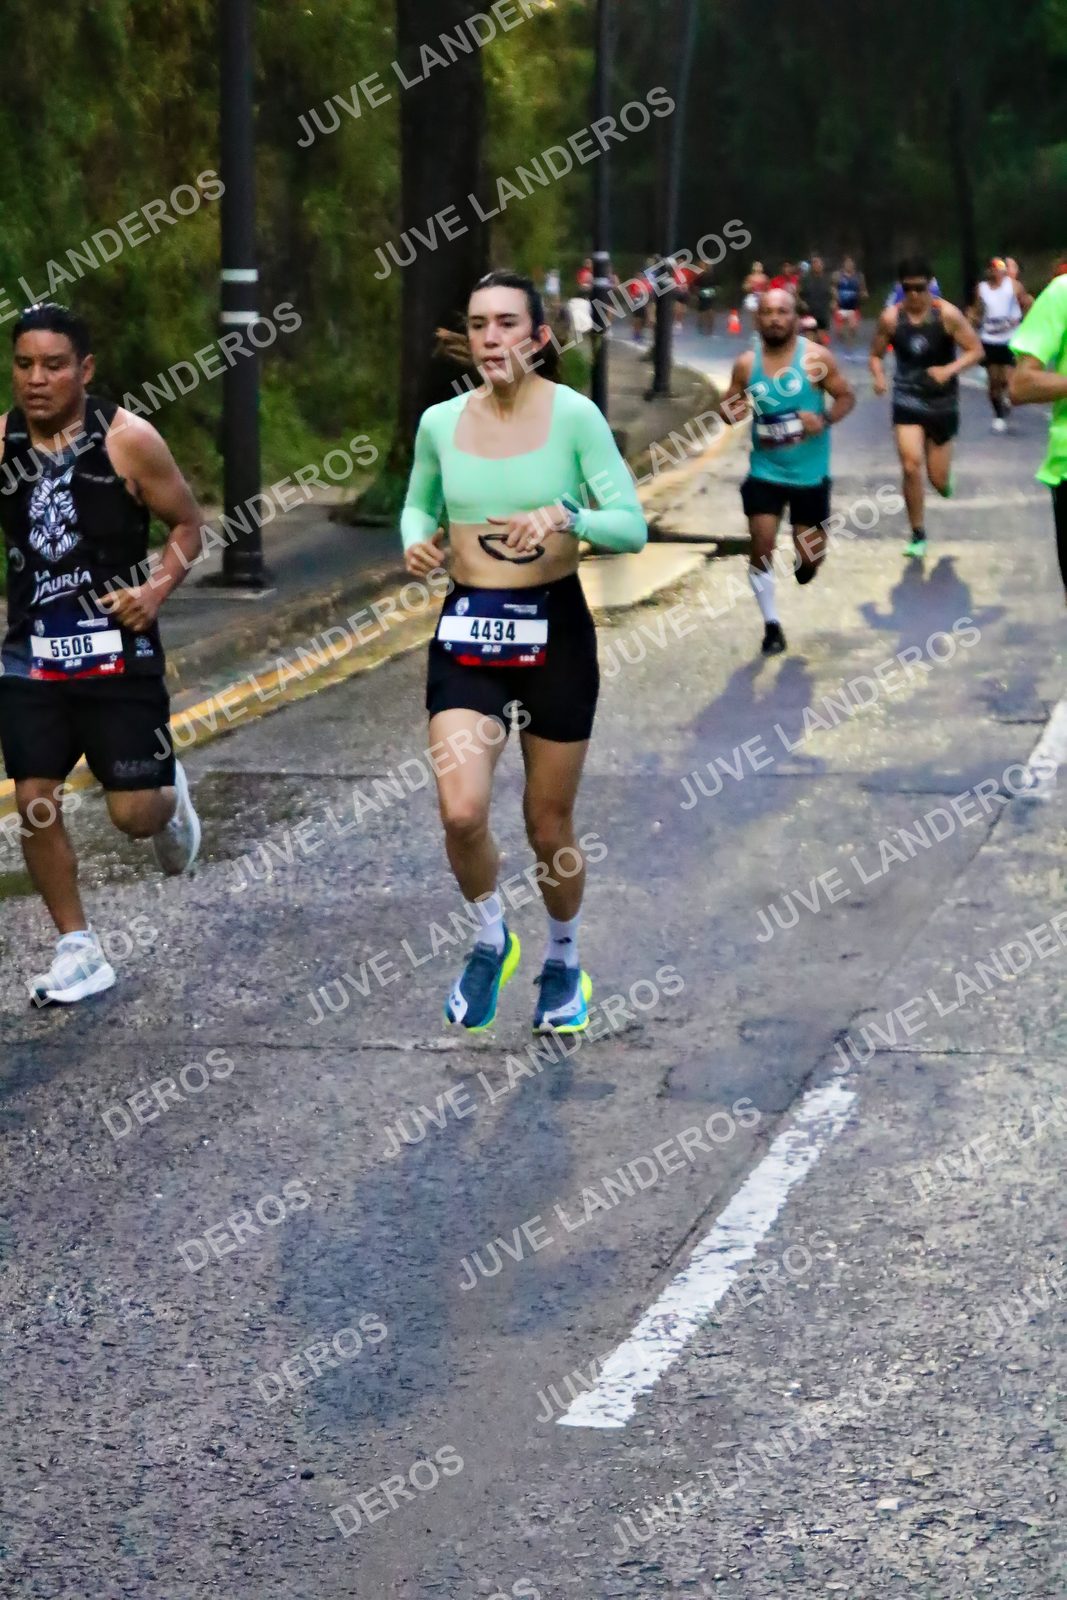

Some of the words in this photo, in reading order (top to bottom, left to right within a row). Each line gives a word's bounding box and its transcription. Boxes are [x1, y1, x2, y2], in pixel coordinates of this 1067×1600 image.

[34, 570, 51, 584] LA
[470, 619, 516, 641] 4434
[50, 635, 94, 658] 5506
